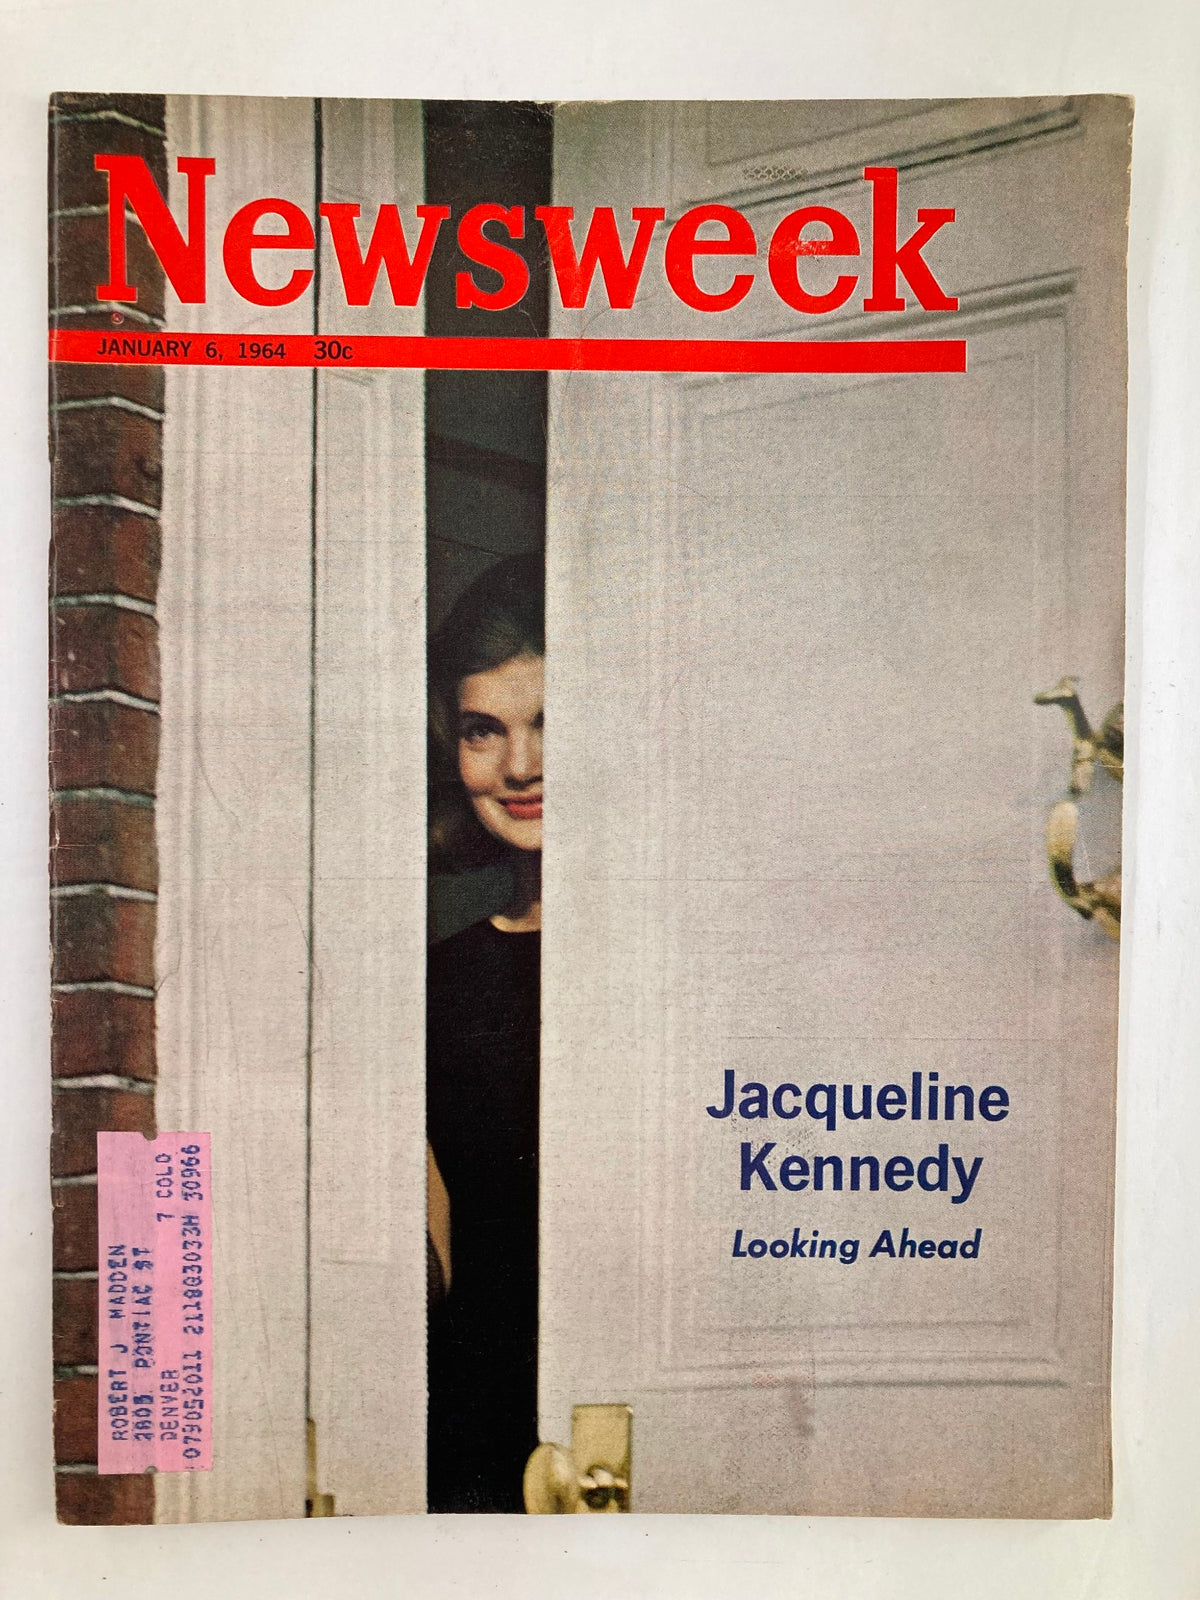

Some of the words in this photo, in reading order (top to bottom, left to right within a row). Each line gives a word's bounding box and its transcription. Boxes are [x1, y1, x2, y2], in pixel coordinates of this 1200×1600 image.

[94, 154, 958, 313] Newsweek
[97, 337, 192, 358] JANUARY
[205, 341, 224, 361] 6,
[238, 342, 287, 360] 1964
[313, 340, 353, 360] 30c
[705, 1069, 1010, 1131] Jacqueline
[155, 1153, 173, 1198] COLO
[740, 1142, 984, 1204] Kennedy
[156, 1211, 174, 1222] 7
[732, 1228, 860, 1265] Looking
[868, 1228, 983, 1259] Ahead
[107, 1244, 128, 1319] MADDEN
[114, 1343, 129, 1354] J
[107, 1369, 128, 1440] ROBERT
[159, 1370, 178, 1440] DENVER
